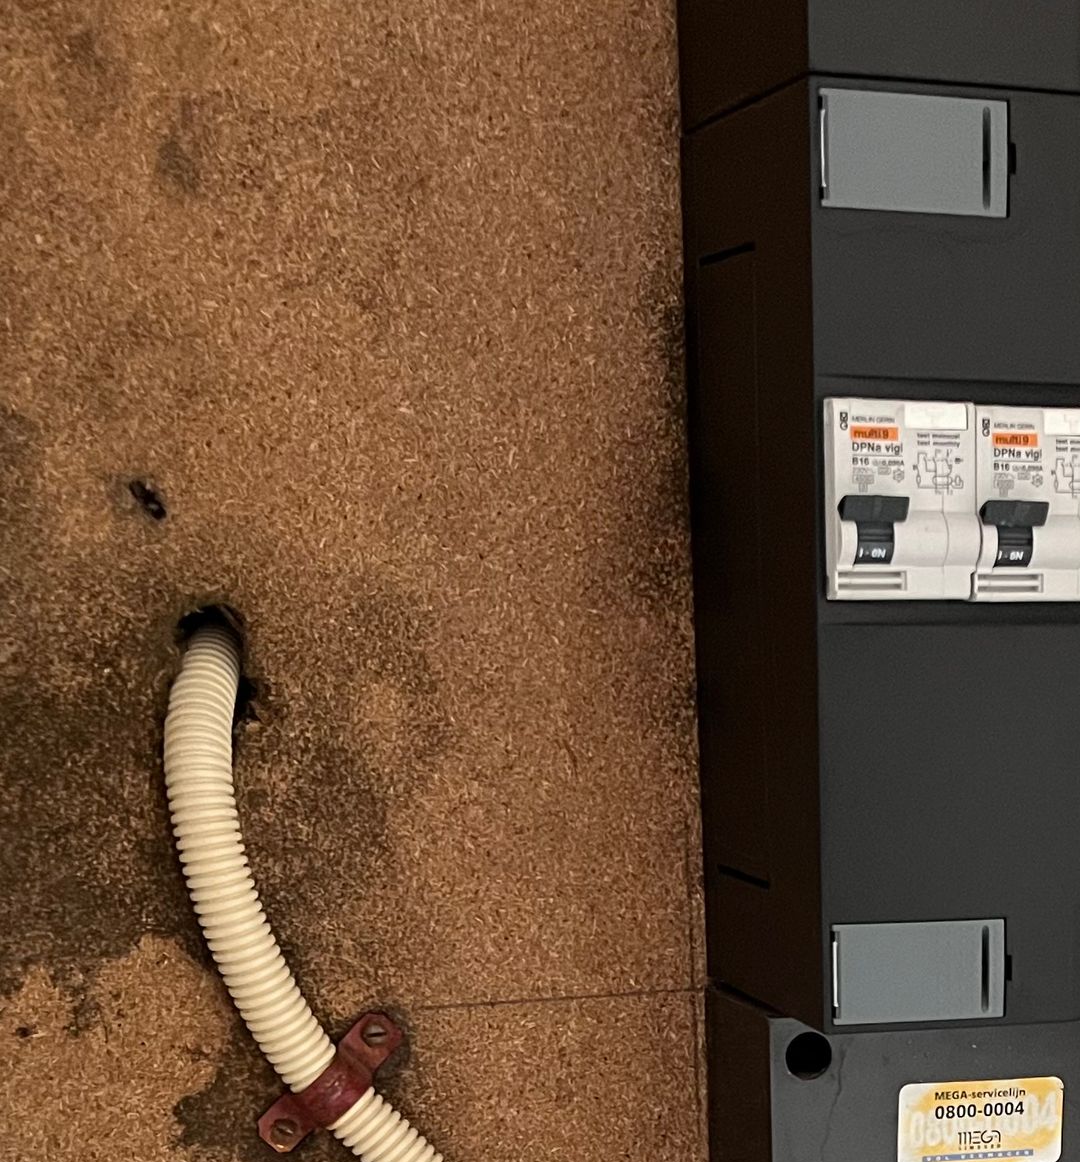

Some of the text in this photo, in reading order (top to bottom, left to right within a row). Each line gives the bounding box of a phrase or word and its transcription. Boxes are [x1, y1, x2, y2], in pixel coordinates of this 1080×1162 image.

[852, 442, 903, 455] DPNa vigi
[994, 448, 1042, 461] DPNa vigi
[934, 1088, 1026, 1101] MEGA-servicelijn
[934, 1101, 1025, 1120] 0800-0004
